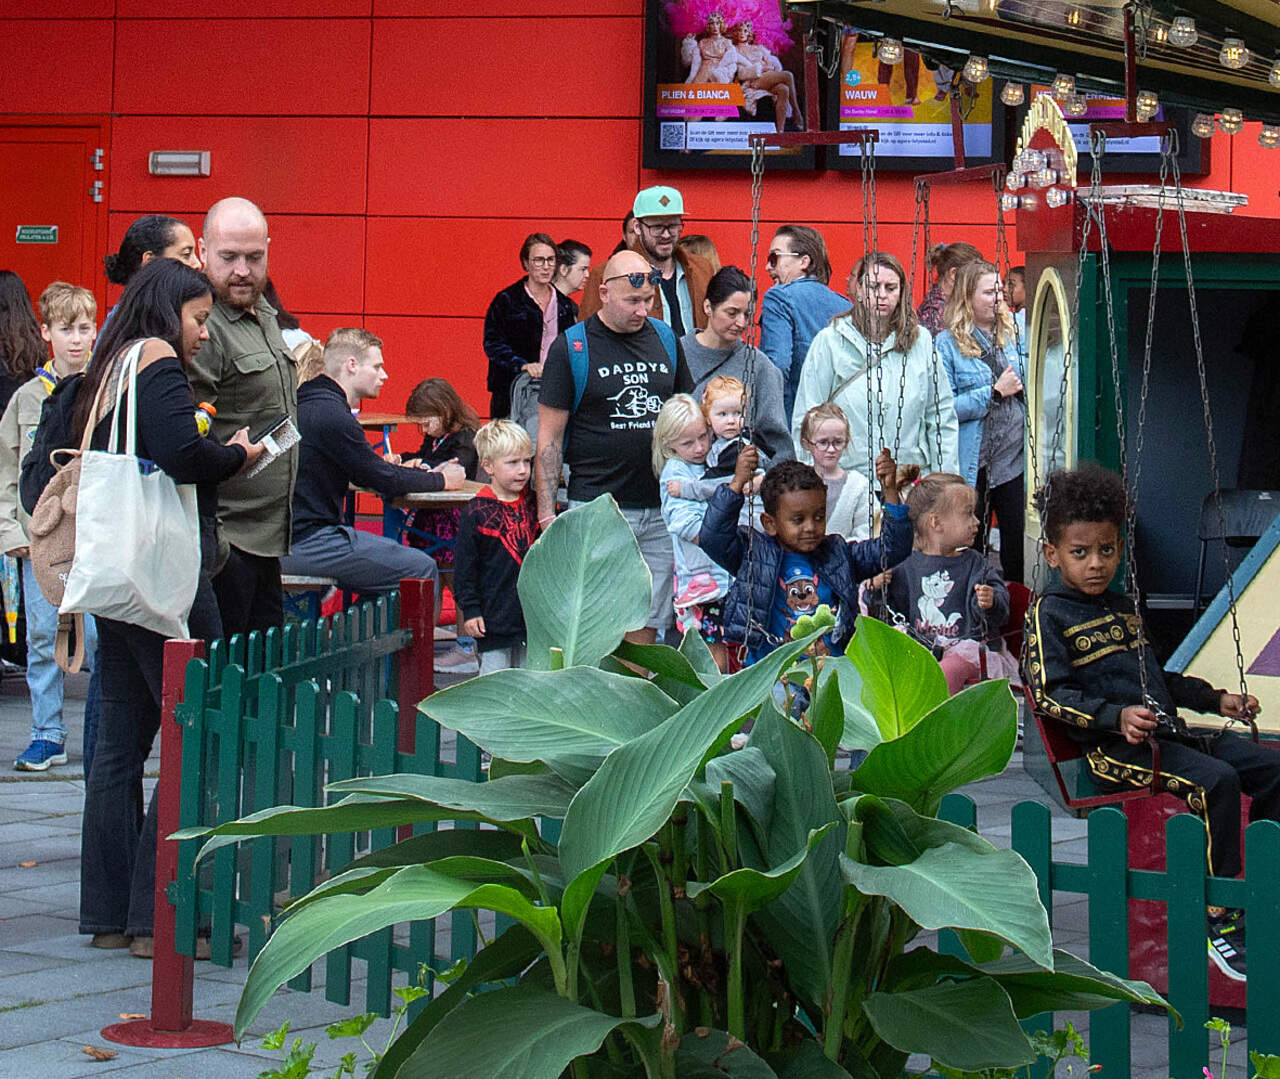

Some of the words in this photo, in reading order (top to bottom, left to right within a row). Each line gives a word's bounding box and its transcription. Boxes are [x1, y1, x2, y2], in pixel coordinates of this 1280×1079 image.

[661, 90, 686, 100] PLIEN
[688, 90, 695, 100] &
[697, 90, 731, 100] BIANCA
[844, 89, 878, 100] WAUW
[622, 373, 649, 385] SON
[610, 421, 626, 430] Best
[628, 420, 651, 430] Friend
